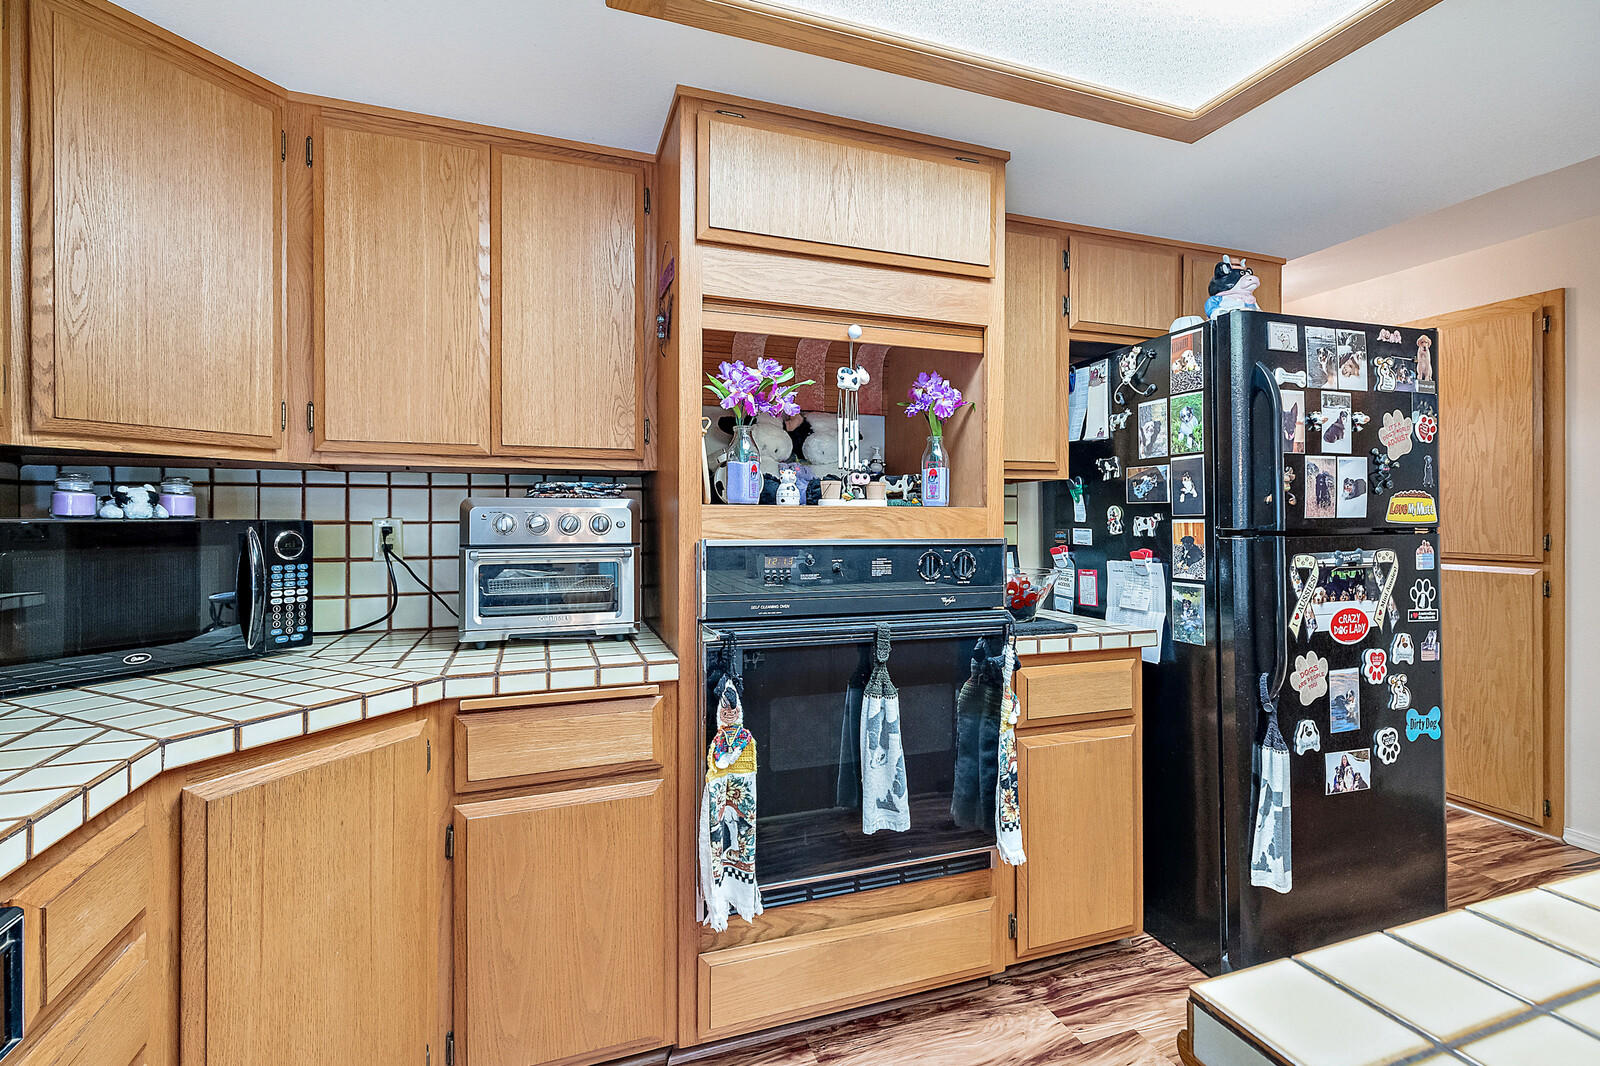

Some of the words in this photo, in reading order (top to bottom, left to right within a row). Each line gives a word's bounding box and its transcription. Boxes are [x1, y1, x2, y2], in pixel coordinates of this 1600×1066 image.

[1389, 502, 1408, 515] Love
[1408, 503, 1416, 516] My
[1416, 502, 1434, 516] Mutt
[1299, 574, 1318, 613] AUSSIES!
[1338, 613, 1360, 624] CRAZY
[1333, 626, 1348, 635] DOG
[1349, 623, 1366, 634] LADY
[1300, 665, 1318, 678] DOGS
[1410, 718, 1426, 730] Dirty
[1426, 718, 1438, 730] Dog
